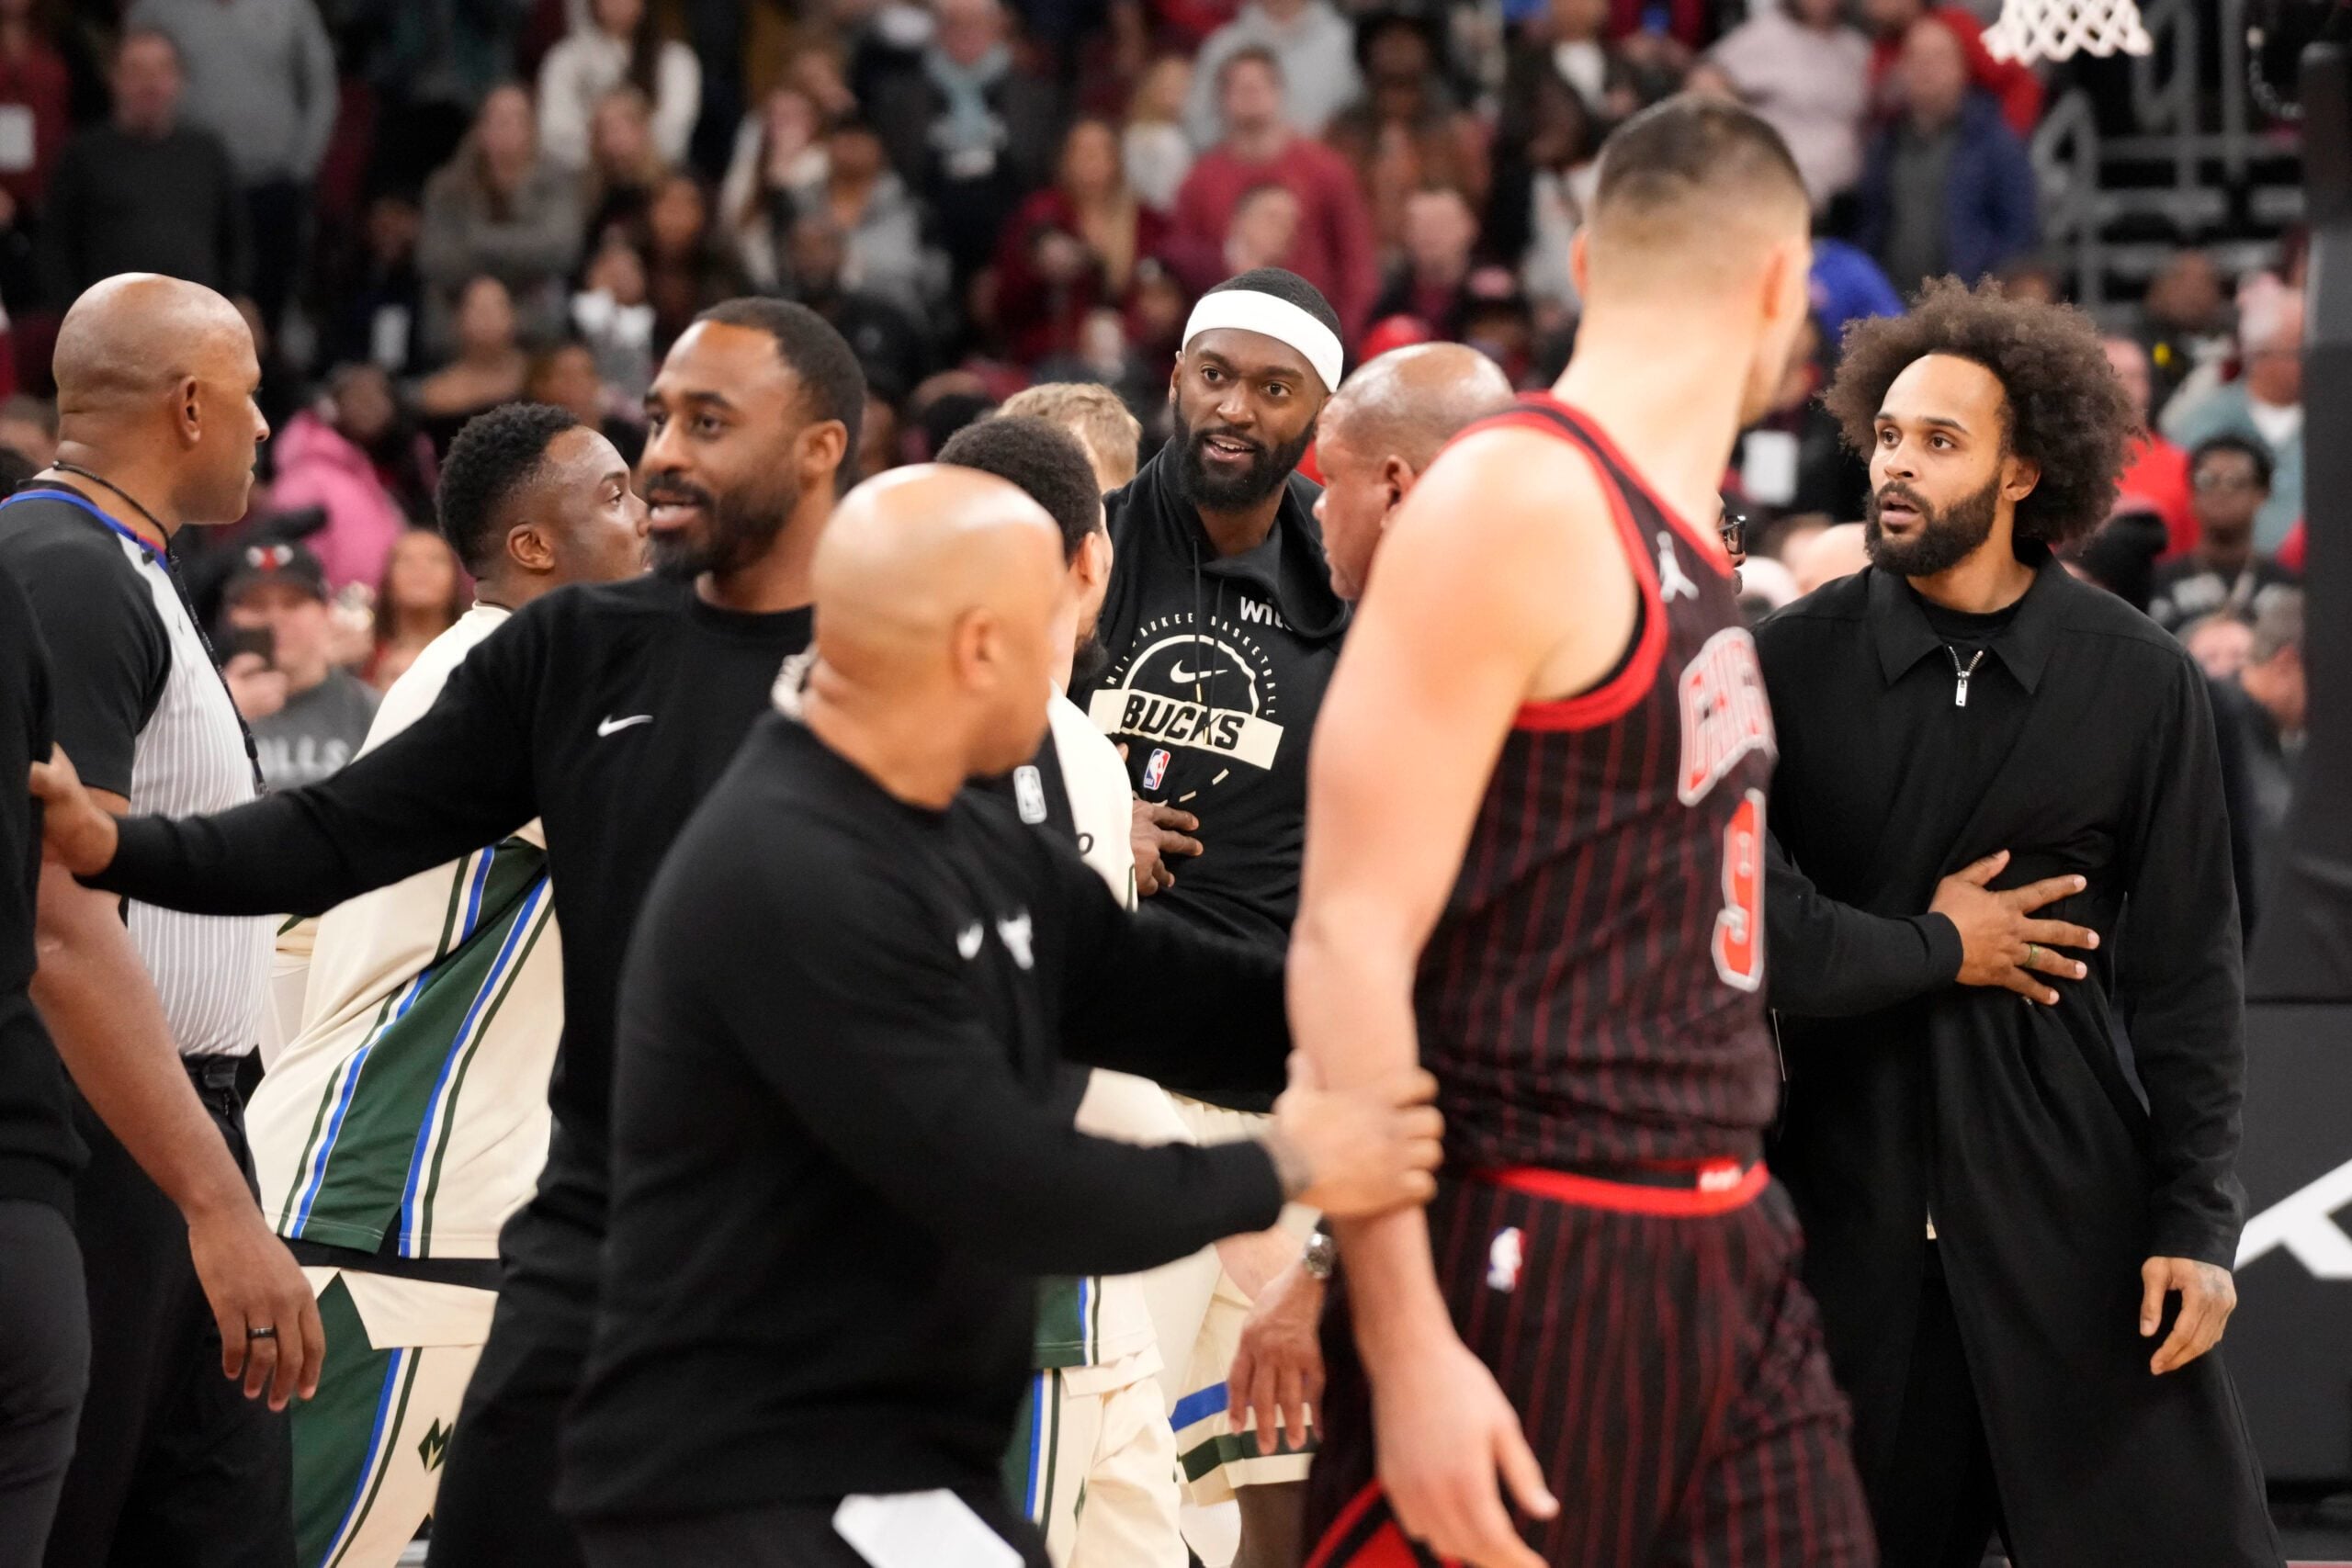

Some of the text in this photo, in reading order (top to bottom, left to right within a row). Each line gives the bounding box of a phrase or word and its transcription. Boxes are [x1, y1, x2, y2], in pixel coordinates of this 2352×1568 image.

[1211, 615, 1276, 716] BASKETBALL
[1120, 694, 1245, 751] BUCKS
[253, 734, 351, 782] ULLS
